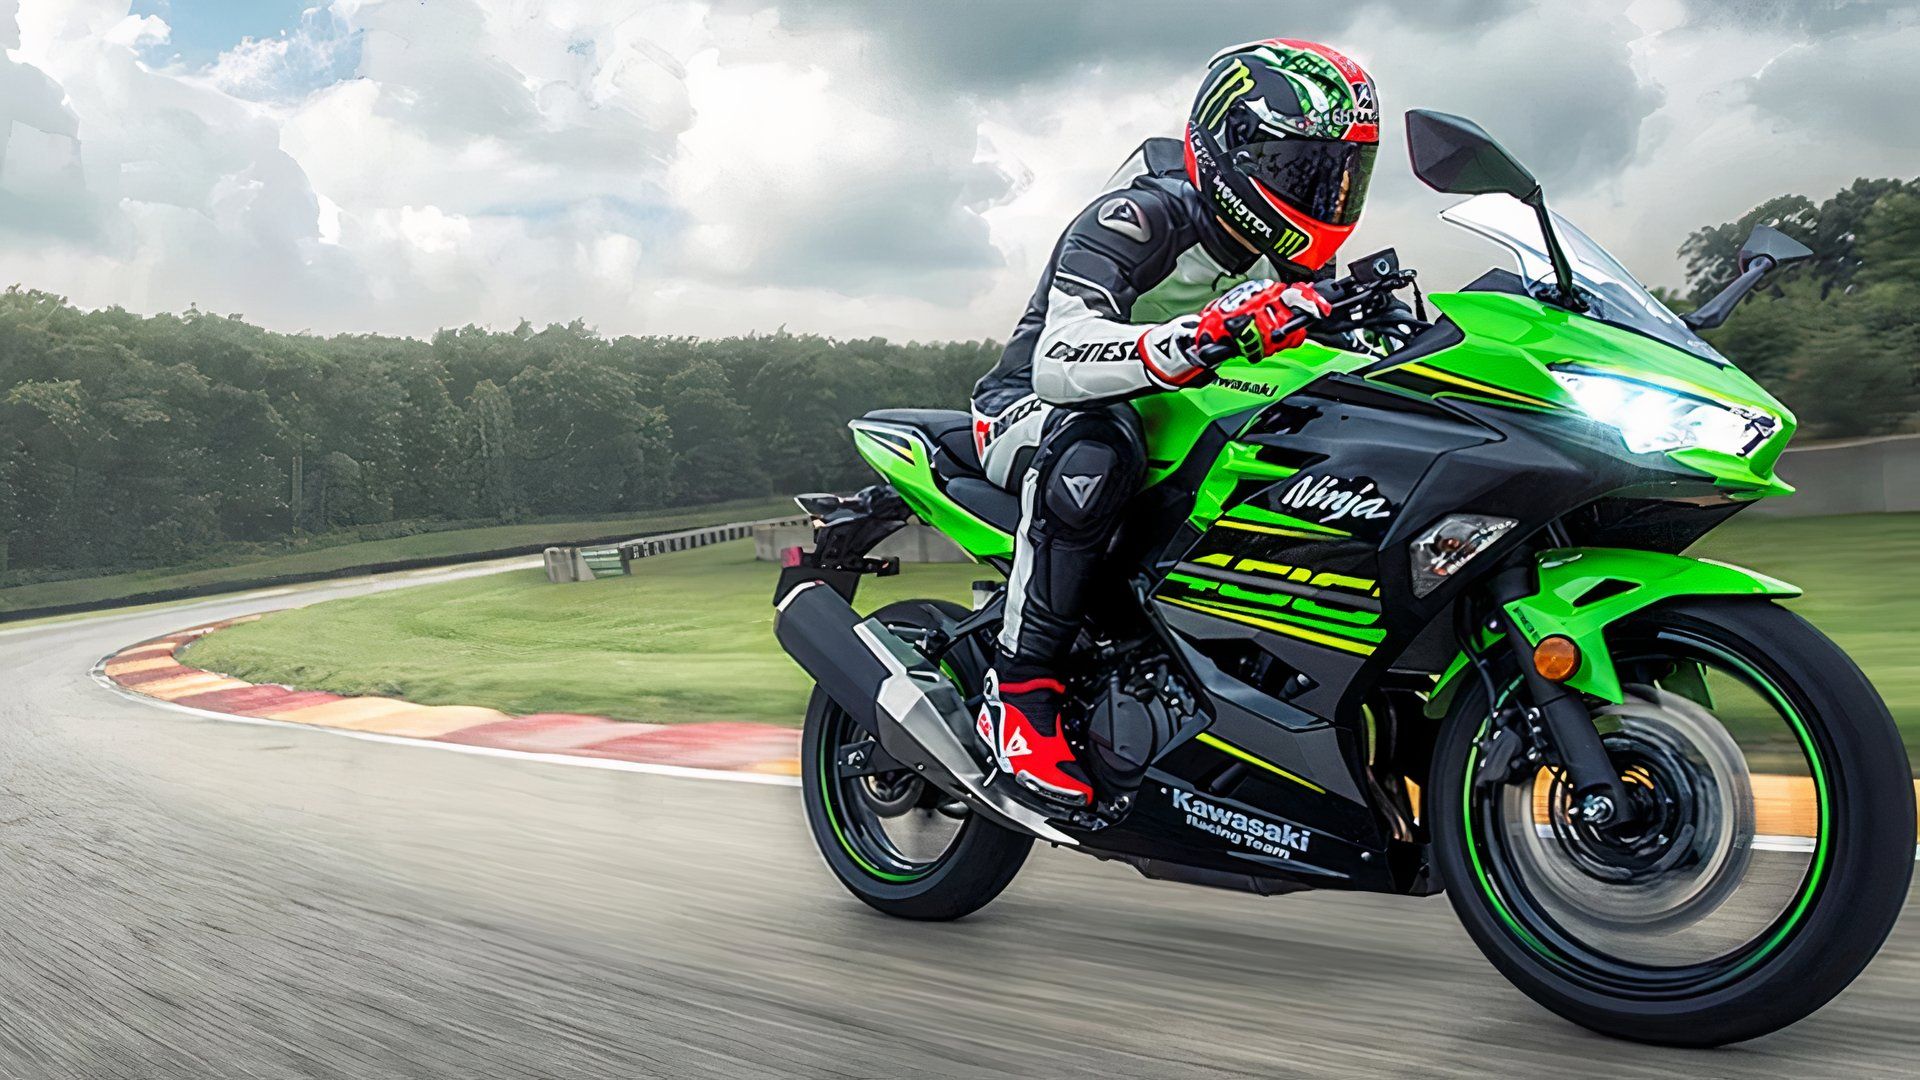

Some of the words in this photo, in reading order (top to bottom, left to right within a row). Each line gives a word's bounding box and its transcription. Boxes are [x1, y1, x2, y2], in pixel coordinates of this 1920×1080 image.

[1281, 475, 1391, 524] Ninja
[1172, 788, 1311, 852] Kawasaki
[1243, 834, 1291, 860] Team
